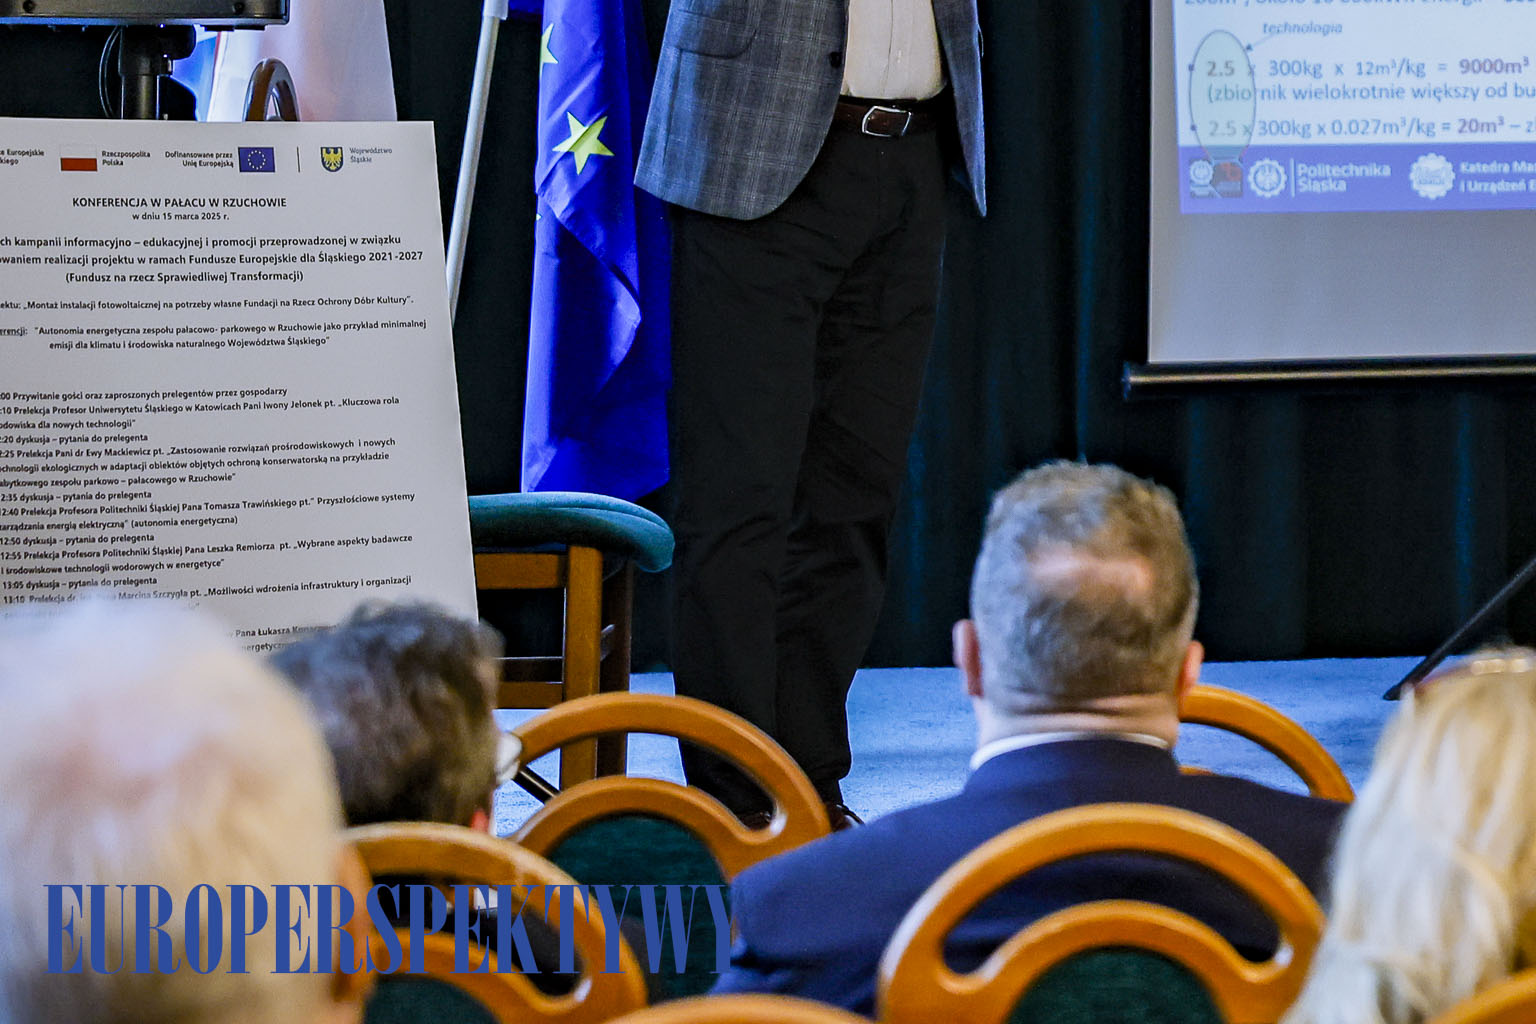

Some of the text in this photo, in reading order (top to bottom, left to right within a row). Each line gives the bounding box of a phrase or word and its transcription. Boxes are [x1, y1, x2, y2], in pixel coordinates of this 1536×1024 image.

[1262, 21, 1343, 38] technologia
[1207, 60, 1236, 77] 2.5
[1269, 59, 1324, 80] 300kg
[1207, 82, 1287, 105] (zbiornik
[1292, 83, 1406, 101] wielokrotnie
[1410, 82, 1480, 103] większy
[1484, 81, 1508, 99] od
[1208, 120, 1237, 136] 2.5
[1258, 119, 1312, 139] 300kg
[6, 148, 45, 158] Europejskie
[101, 150, 151, 161] Rzeczpospolita
[164, 150, 233, 162] Dofinansowane przez
[349, 147, 393, 158] Województwo
[101, 158, 124, 167] Polska
[182, 159, 234, 169] Unię Europejską
[350, 154, 372, 164] Śląskie
[72, 197, 287, 208] KONFERENCJA W PAŁACU W RZUCHOWIE
[141, 211, 161, 220] dniu
[162, 212, 173, 221] 15
[174, 213, 200, 221] marca
[201, 212, 222, 221] 2025
[14, 236, 62, 249] kampanii
[64, 236, 132, 250] informacyjno
[142, 236, 203, 250] edukacyjnej
[211, 236, 257, 249] promocji
[259, 235, 347, 249] przeprowadzonej
[349, 237, 359, 245] w
[360, 234, 401, 247] związku
[44, 250, 424, 267] realizacji projektu w ramach Fundusze Europejskie dla Śląskiego 2021 -2027
[65, 270, 304, 284] (Fundusz na rzecz Sprawiedliwej Transformacji)
[12, 391, 60, 402] Przywitanie
[61, 391, 84, 402] gości
[104, 390, 160, 401] zaproszonych
[162, 389, 214, 400] prelegentów
[215, 390, 238, 399] przez
[239, 387, 288, 399] gospodarzy
